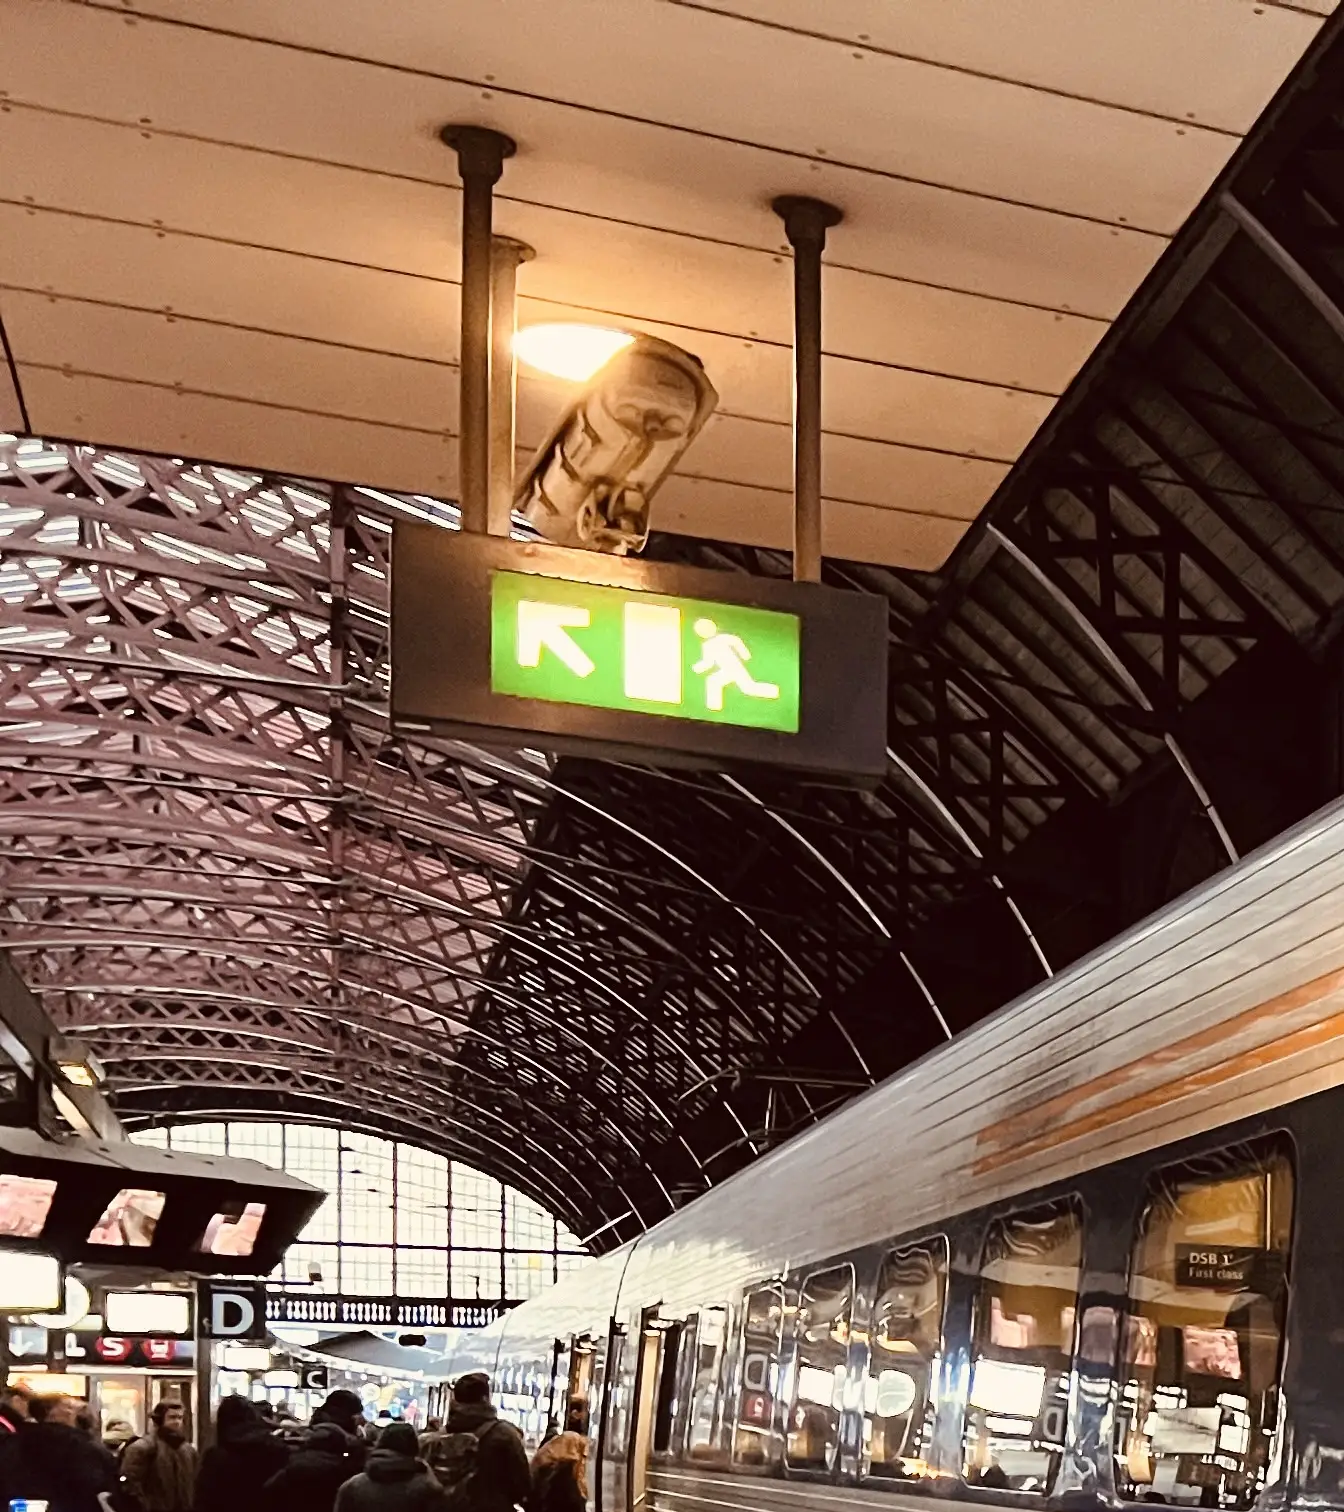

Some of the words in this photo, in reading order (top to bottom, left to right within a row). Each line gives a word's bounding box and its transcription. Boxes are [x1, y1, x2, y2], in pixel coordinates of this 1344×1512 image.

[1189, 1252, 1218, 1265] DSB
[1189, 1266, 1213, 1279] First
[1216, 1268, 1244, 1280] class
[211, 1293, 255, 1335] D
[102, 1337, 125, 1356] S
[306, 1370, 320, 1388] C
